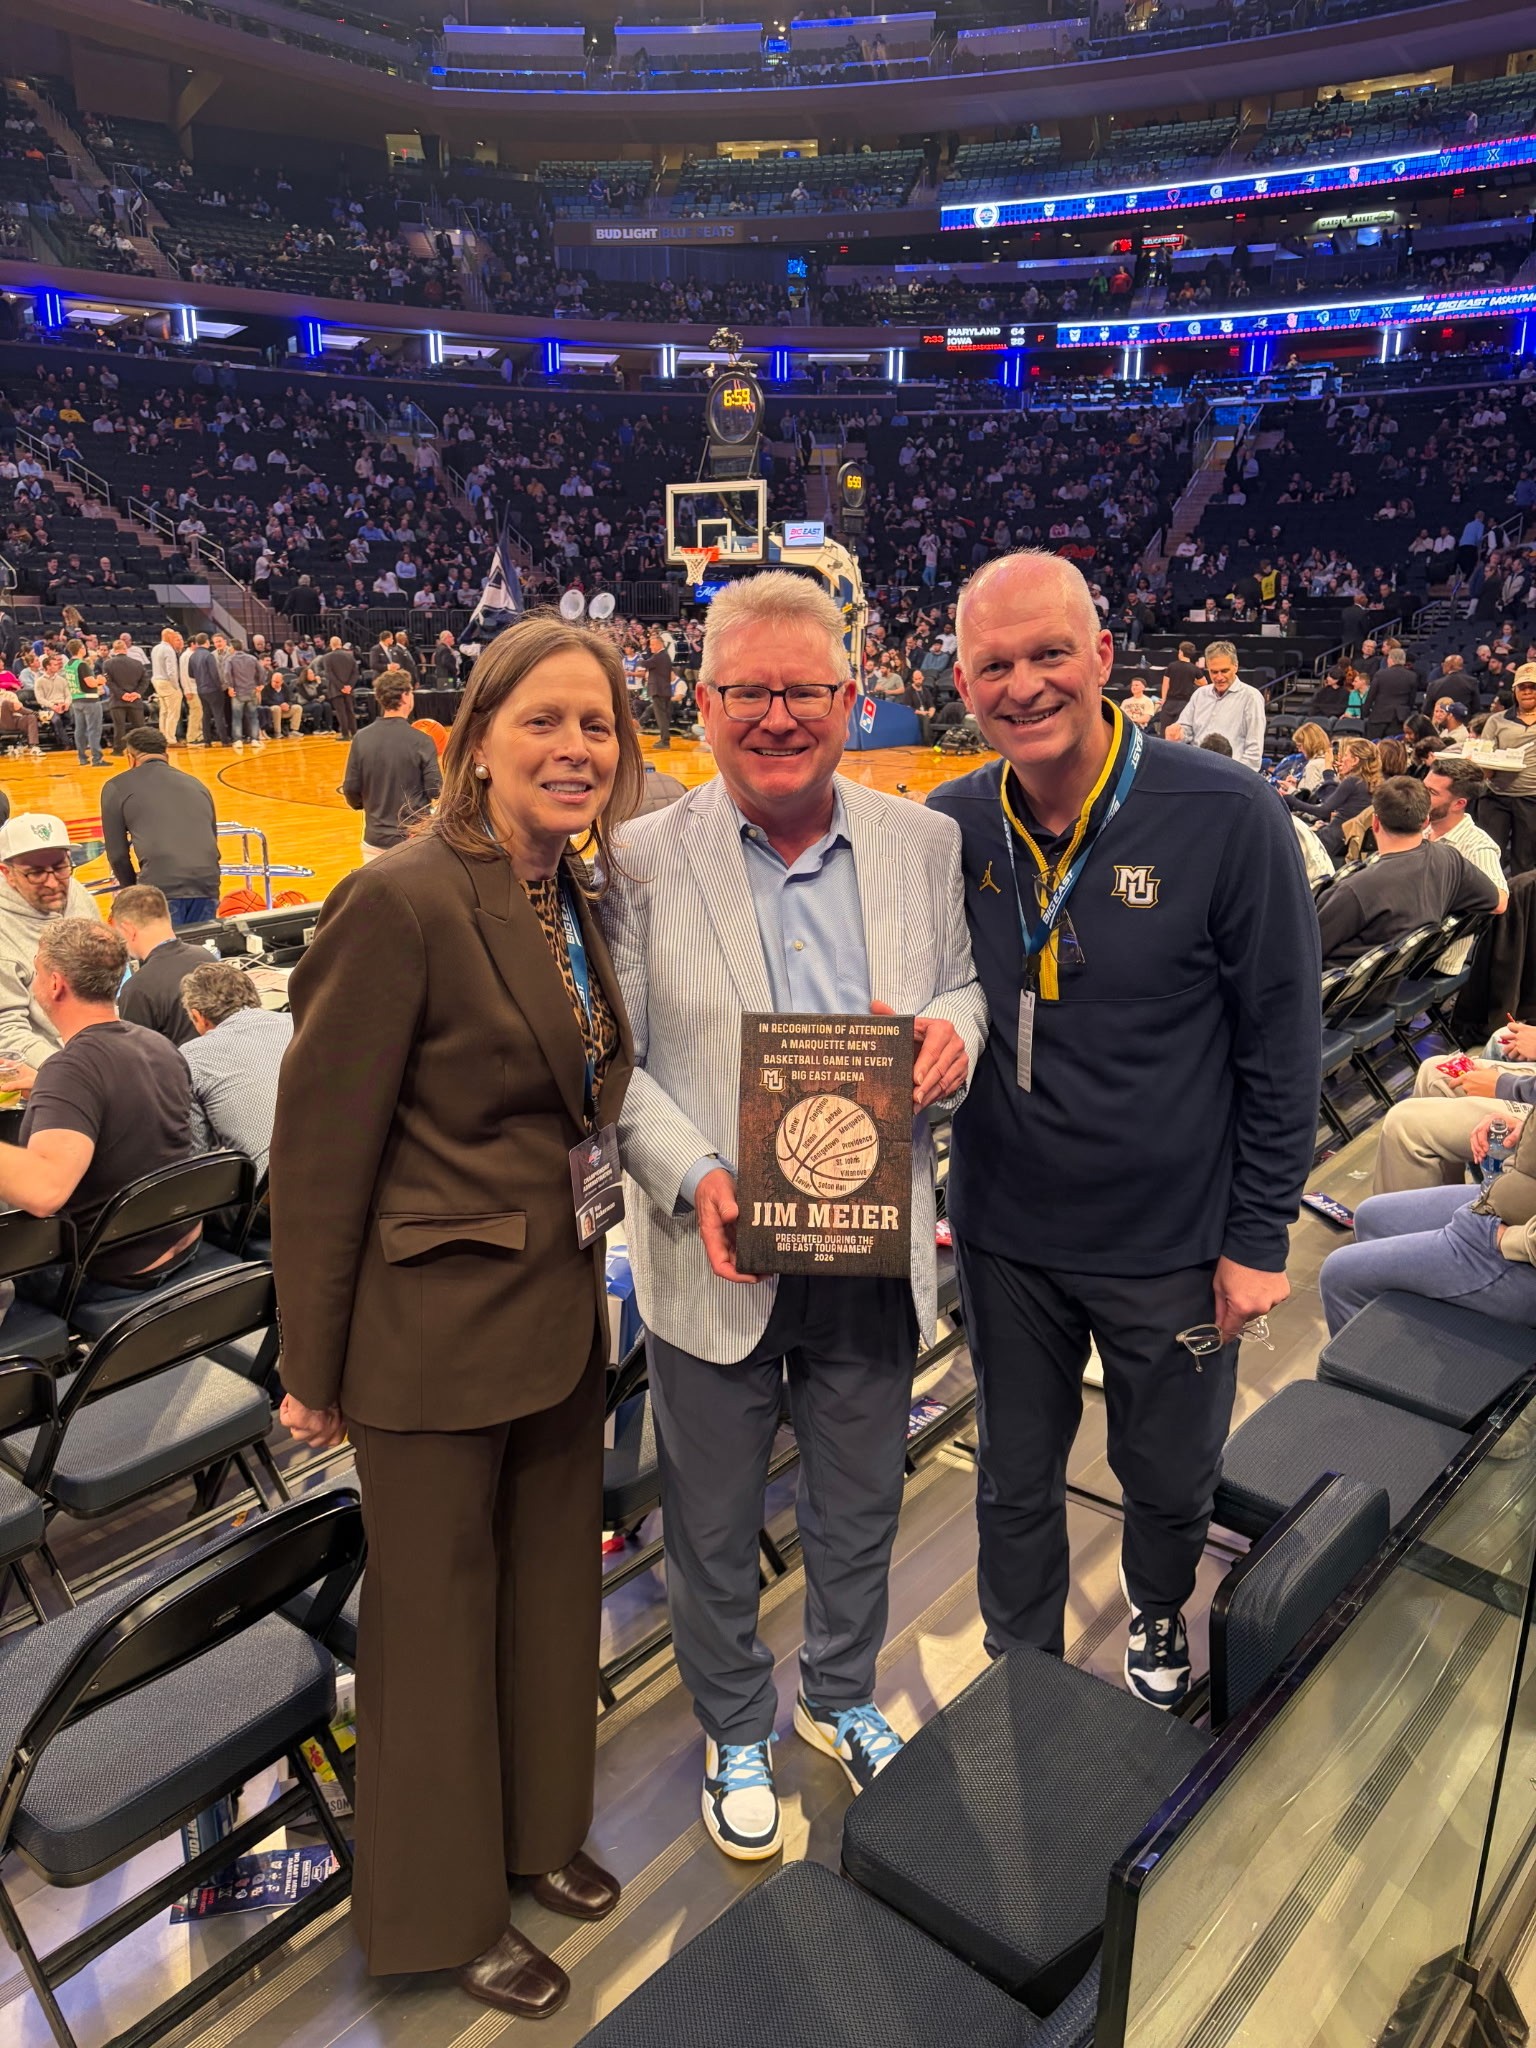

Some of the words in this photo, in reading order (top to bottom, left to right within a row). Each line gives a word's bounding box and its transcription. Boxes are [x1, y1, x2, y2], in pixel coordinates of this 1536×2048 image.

[596, 229, 622, 239] BUD
[622, 228, 658, 239] LIGHT
[662, 227, 691, 238] BLUE
[695, 226, 735, 237] SEATS
[1410, 302, 1435, 313] 2026
[1436, 300, 1459, 309] BIG
[1459, 298, 1489, 308] EAST
[947, 327, 1000, 336] MARYLAND
[947, 337, 972, 345] IOWA
[724, 388, 750, 406] 6:59
[1114, 867, 1158, 906] MU
[759, 1023, 769, 1033] IN
[771, 1023, 832, 1034] RECOGNITION
[835, 1025, 846, 1034] OF
[849, 1025, 900, 1036] ATTENDING
[781, 1039, 787, 1049] A
[790, 1039, 845, 1050] MARQUETTE
[847, 1040, 876, 1051] MEN'S
[764, 1054, 820, 1065] BASKETBALL
[823, 1056, 849, 1066] GAME
[852, 1056, 861, 1066] IN
[864, 1057, 893, 1066] EVERY
[761, 1069, 785, 1092] MU
[791, 1070, 806, 1080] BIG
[809, 1071, 832, 1081] EAST
[834, 1072, 865, 1082] ARENA
[809, 1098, 828, 1122] Creighton
[825, 1107, 842, 1124] DePaul
[788, 1117, 800, 1134] Butler
[838, 1113, 865, 1134] Marquette
[842, 1135, 872, 1150] Providence
[810, 1138, 840, 1162] Georgetown
[796, 1176, 812, 1190] Xavier
[818, 1182, 834, 1190] Seton
[751, 1202, 797, 1227] JIM
[808, 1204, 899, 1230] MEIER
[775, 1234, 822, 1244] PRESENTED
[825, 1235, 856, 1244] DURING
[858, 1236, 874, 1245] THE
[777, 1243, 790, 1252] BIG
[793, 1243, 814, 1252] EAST
[816, 1244, 872, 1254] TOURNAMENT
[284, 1858, 293, 1895] BASKETBALL
[292, 1864, 300, 1878] EAST
